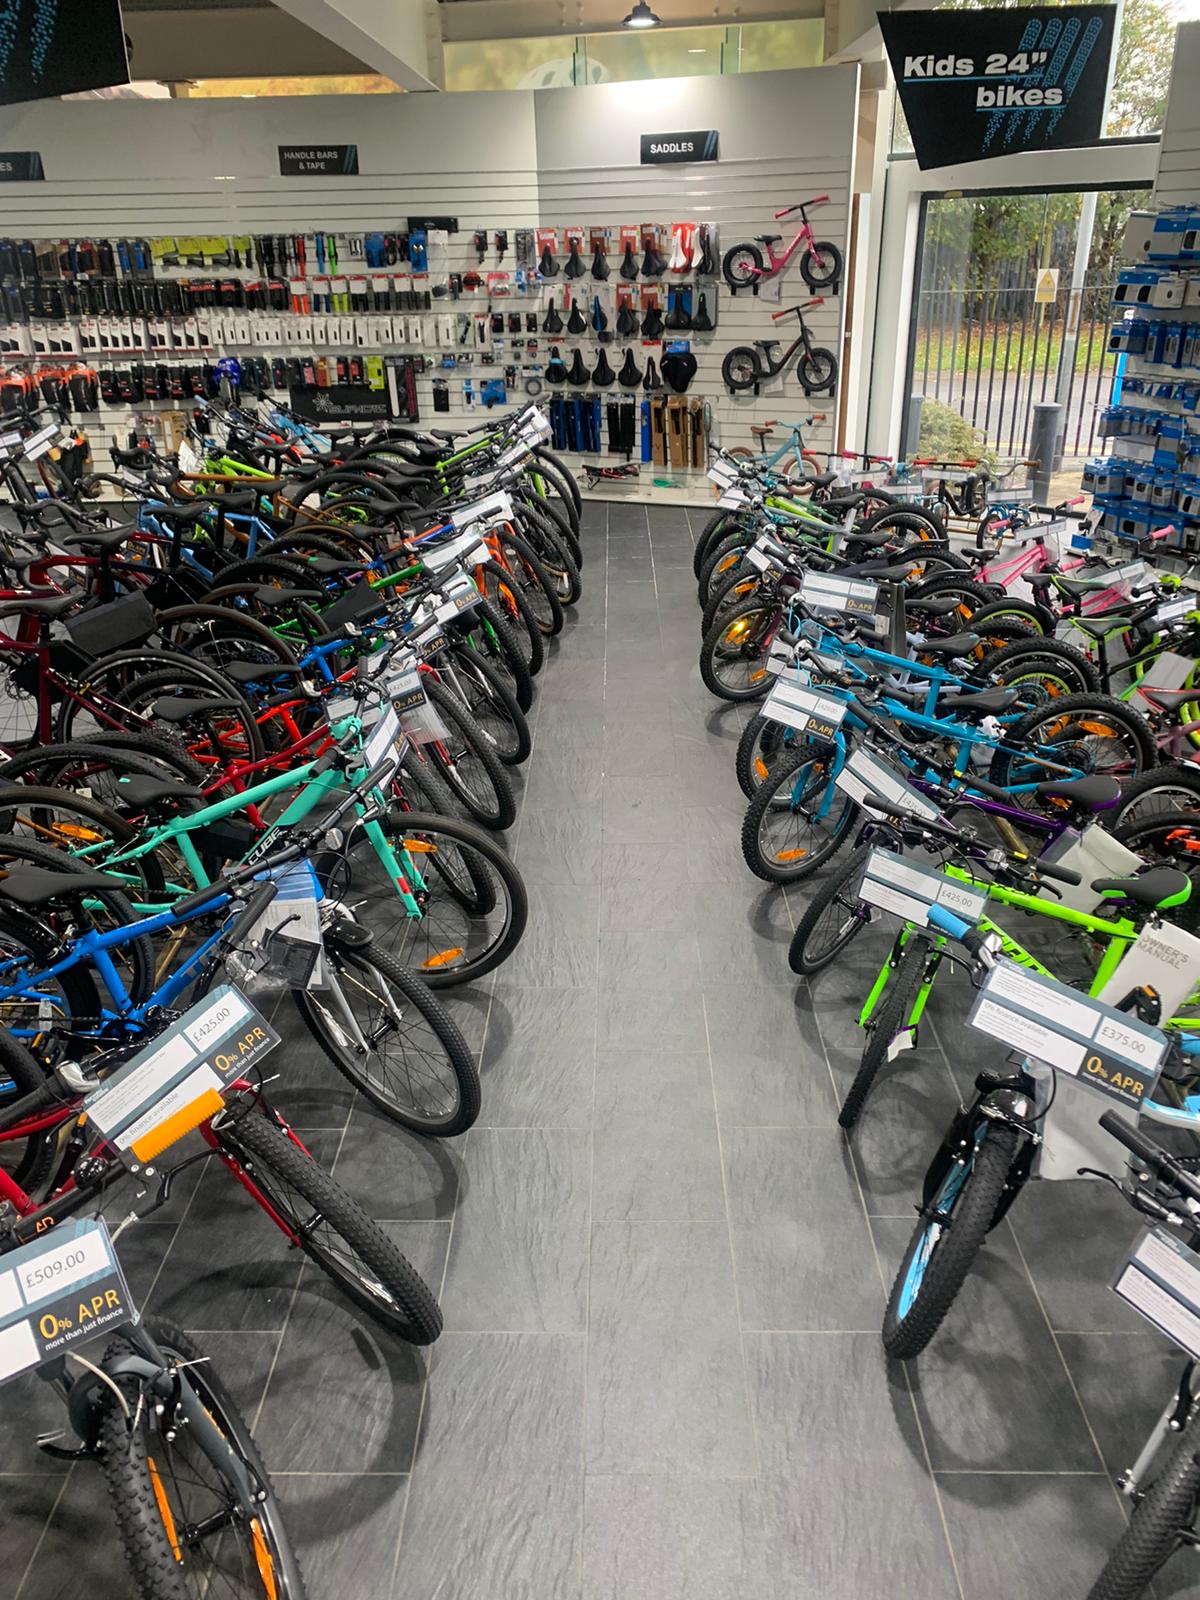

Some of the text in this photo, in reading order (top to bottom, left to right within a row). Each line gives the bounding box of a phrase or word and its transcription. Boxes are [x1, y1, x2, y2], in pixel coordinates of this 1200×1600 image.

[903, 55, 975, 77] Kids
[976, 86, 1063, 107] bikes
[284, 151, 338, 160] HANDLE BARS
[650, 142, 694, 154] SADDLES
[299, 162, 326, 170] & TAPE
[407, 692, 424, 705] APR
[818, 725, 834, 737] APR
[248, 826, 281, 866] CUBE
[941, 889, 973, 908] £425.00
[1136, 941, 1181, 970] MANUAL
[192, 1007, 231, 1042] £425.00
[238, 1026, 266, 1055] APR
[1101, 1026, 1147, 1054] £375.00
[1110, 1072, 1144, 1097] APR
[25, 1249, 86, 1289] £509.00
[39, 1288, 121, 1340] 0% APR
[44, 1307, 124, 1351] more than just finance
